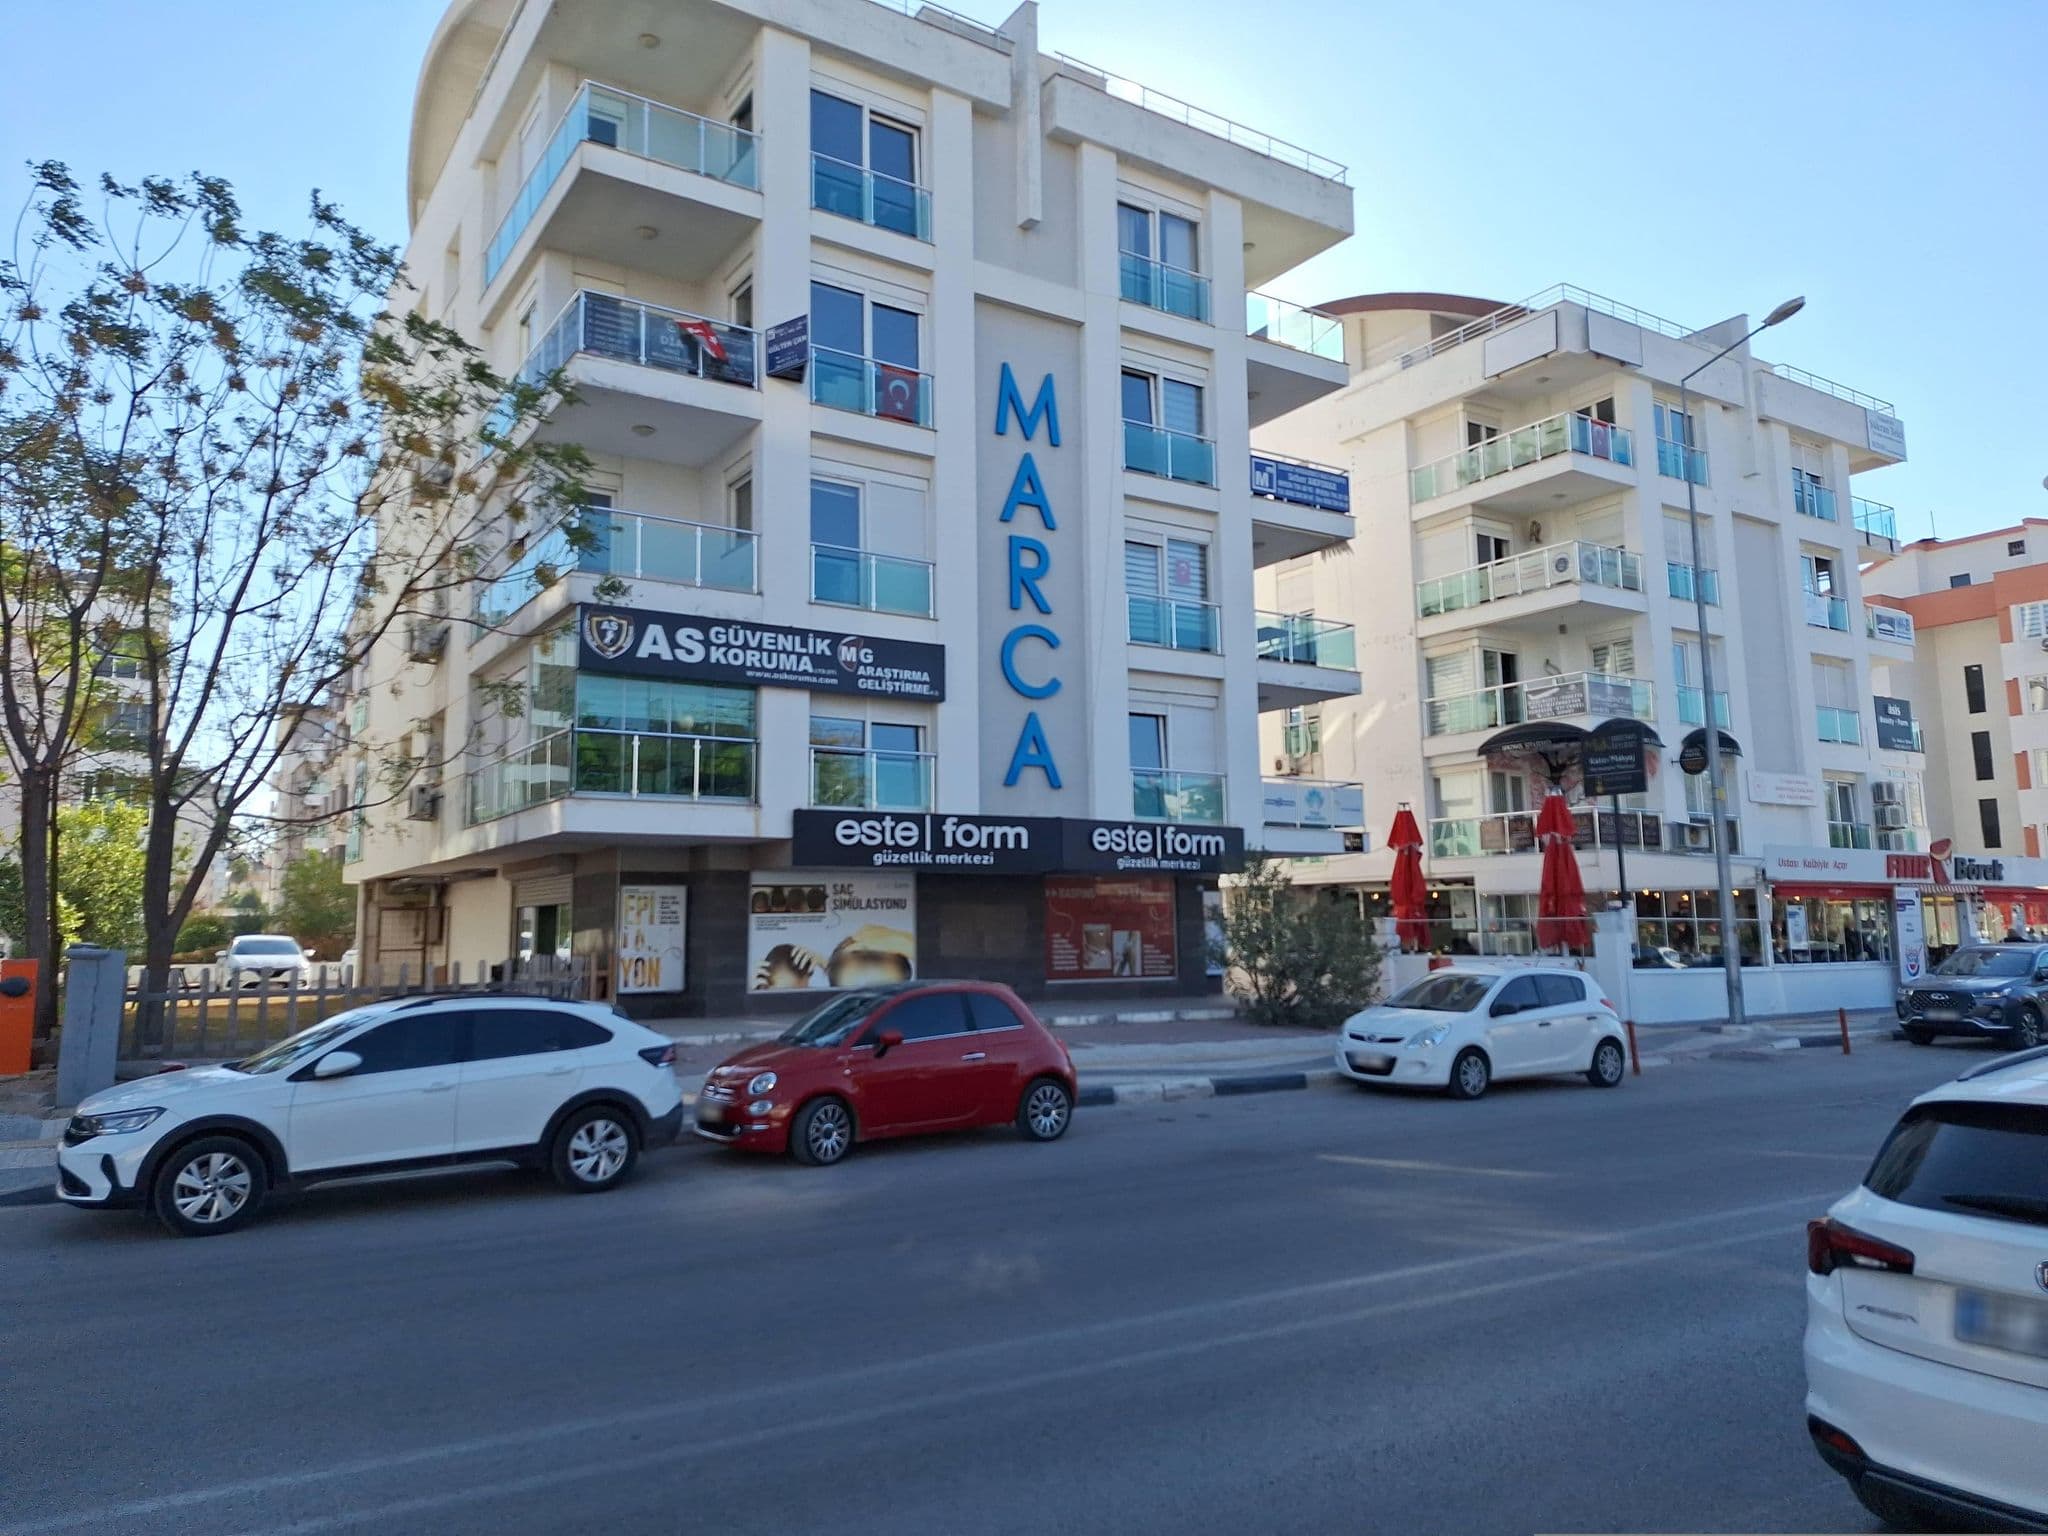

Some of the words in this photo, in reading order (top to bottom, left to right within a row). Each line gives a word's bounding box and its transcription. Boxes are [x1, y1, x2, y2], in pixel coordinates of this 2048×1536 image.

[995, 362, 1062, 790] MARCA
[636, 624, 705, 664] AS
[709, 625, 832, 656] GÜVENLİK
[709, 646, 815, 673] KORUMA
[857, 665, 930, 682] ARAŞTIRMA
[858, 678, 931, 695] GELİŞTİRME
[835, 815, 919, 847] este
[942, 817, 1029, 850] form
[1092, 825, 1152, 853] este
[1164, 826, 1225, 856] form
[873, 850, 933, 866] güzellik
[936, 852, 994, 865] merkezi
[1117, 856, 1159, 870] güzellik
